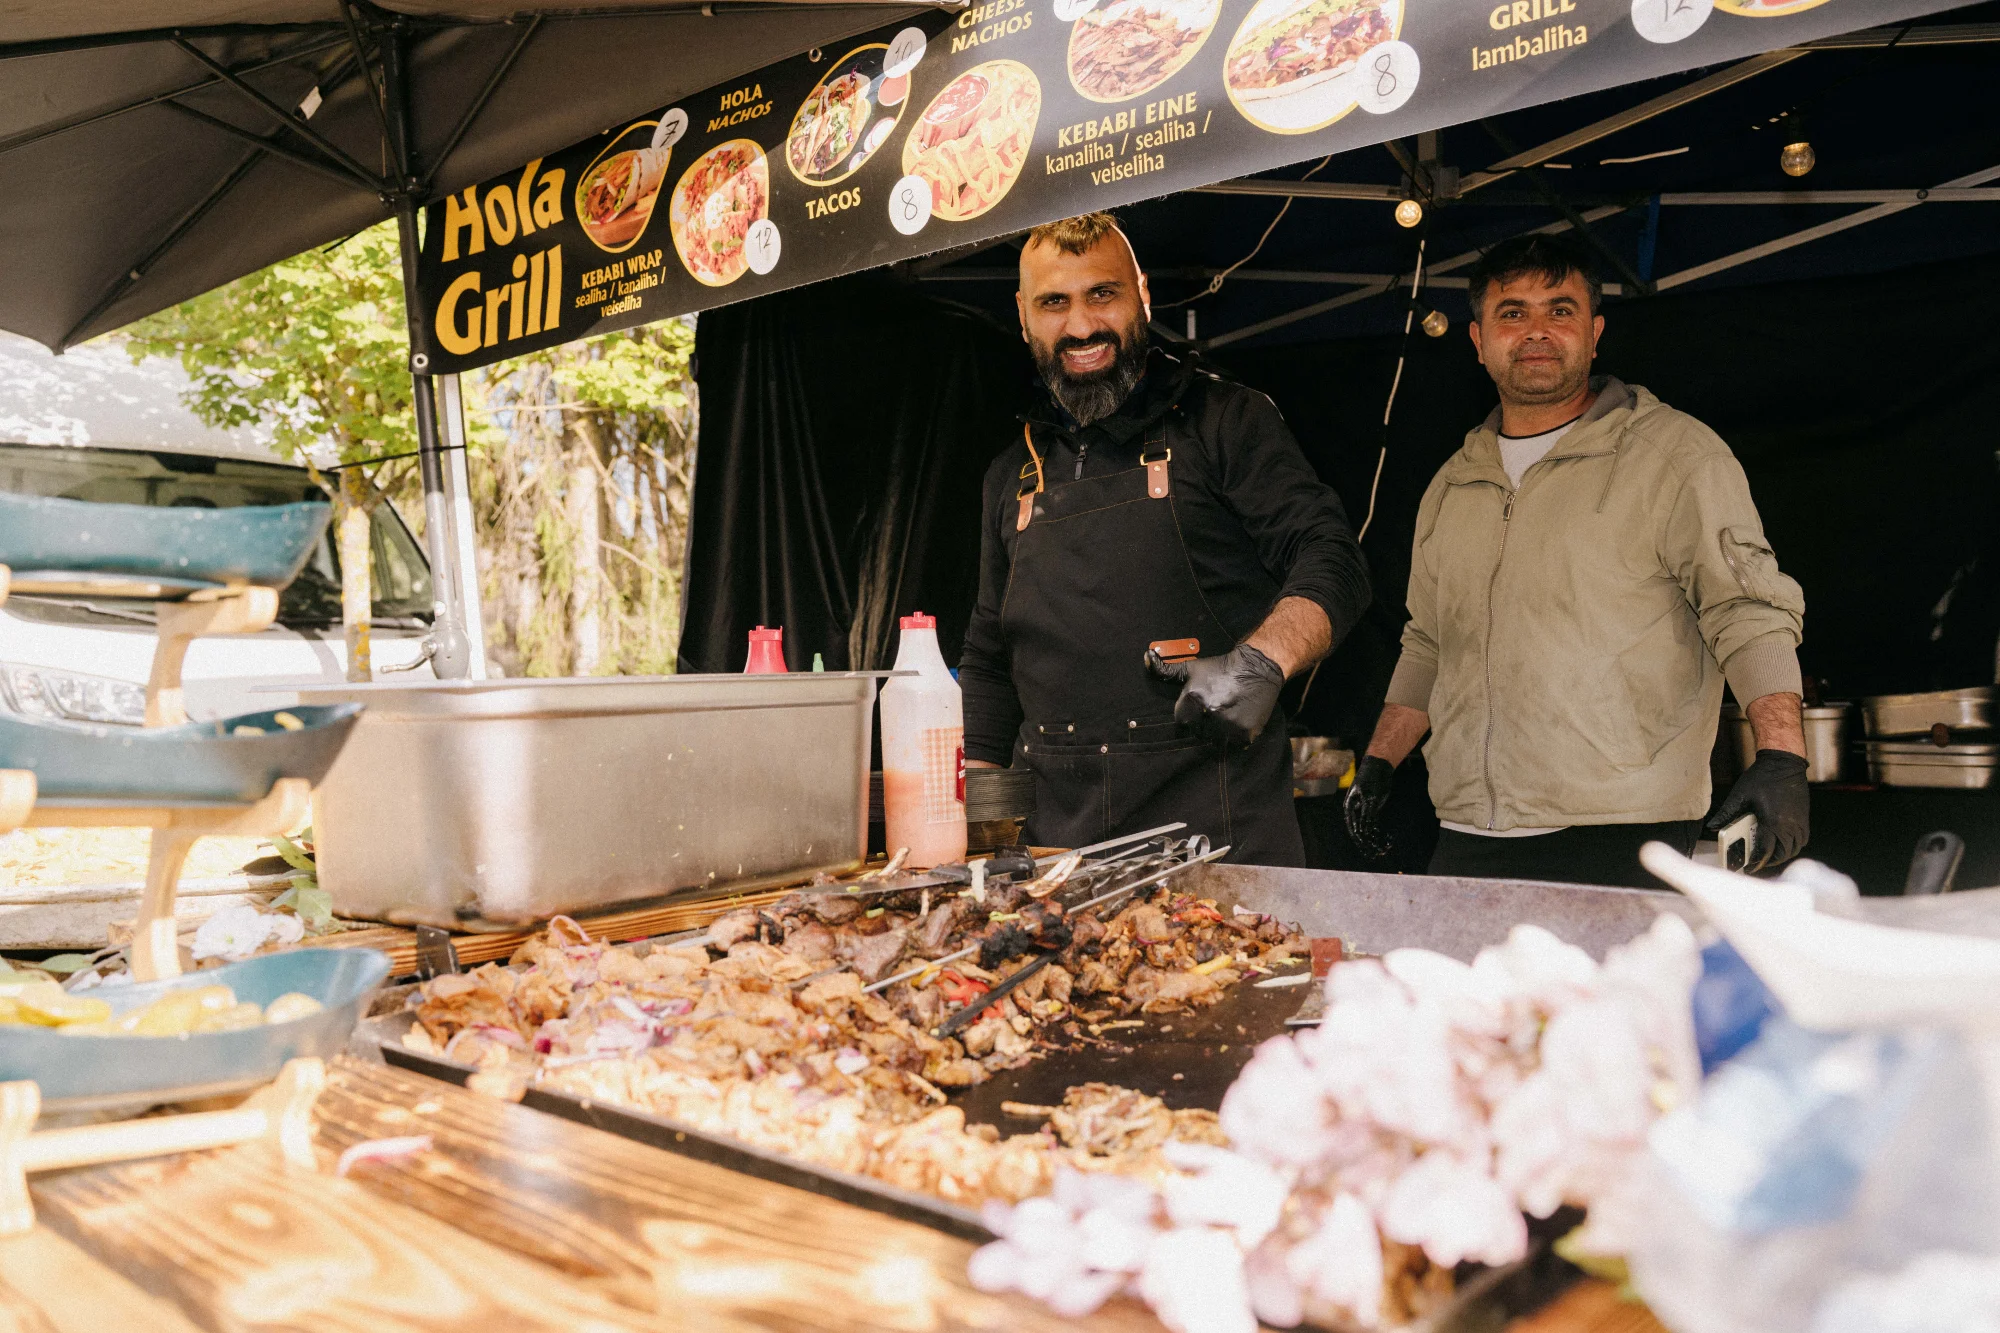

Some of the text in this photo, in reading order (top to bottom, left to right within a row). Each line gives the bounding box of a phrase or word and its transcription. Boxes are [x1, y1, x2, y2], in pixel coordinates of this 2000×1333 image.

[958, 0, 1026, 29] CHEESE
[1489, 0, 1577, 31] GRILL
[951, 11, 1033, 54] NACHOS
[1472, 24, 1588, 71] lambaliha
[1375, 53, 1397, 97] 8
[720, 83, 763, 111] HOLA
[659, 119, 680, 148] 7
[706, 100, 773, 133] NACHOS
[1058, 91, 1198, 148] KEBABI EINE
[1046, 110, 1213, 175] kanaliha / sealiha /
[1091, 152, 1165, 186] veiseliha
[441, 157, 566, 263] Hola
[805, 187, 861, 220] TACOS
[901, 188, 919, 221] 8
[755, 227, 772, 254] 12
[581, 249, 663, 290] KEBABI WRAP
[435, 244, 562, 356] Grill
[574, 287, 607, 309] sealiha
[617, 271, 658, 297] kanaliha
[600, 294, 642, 318] veiseliha
